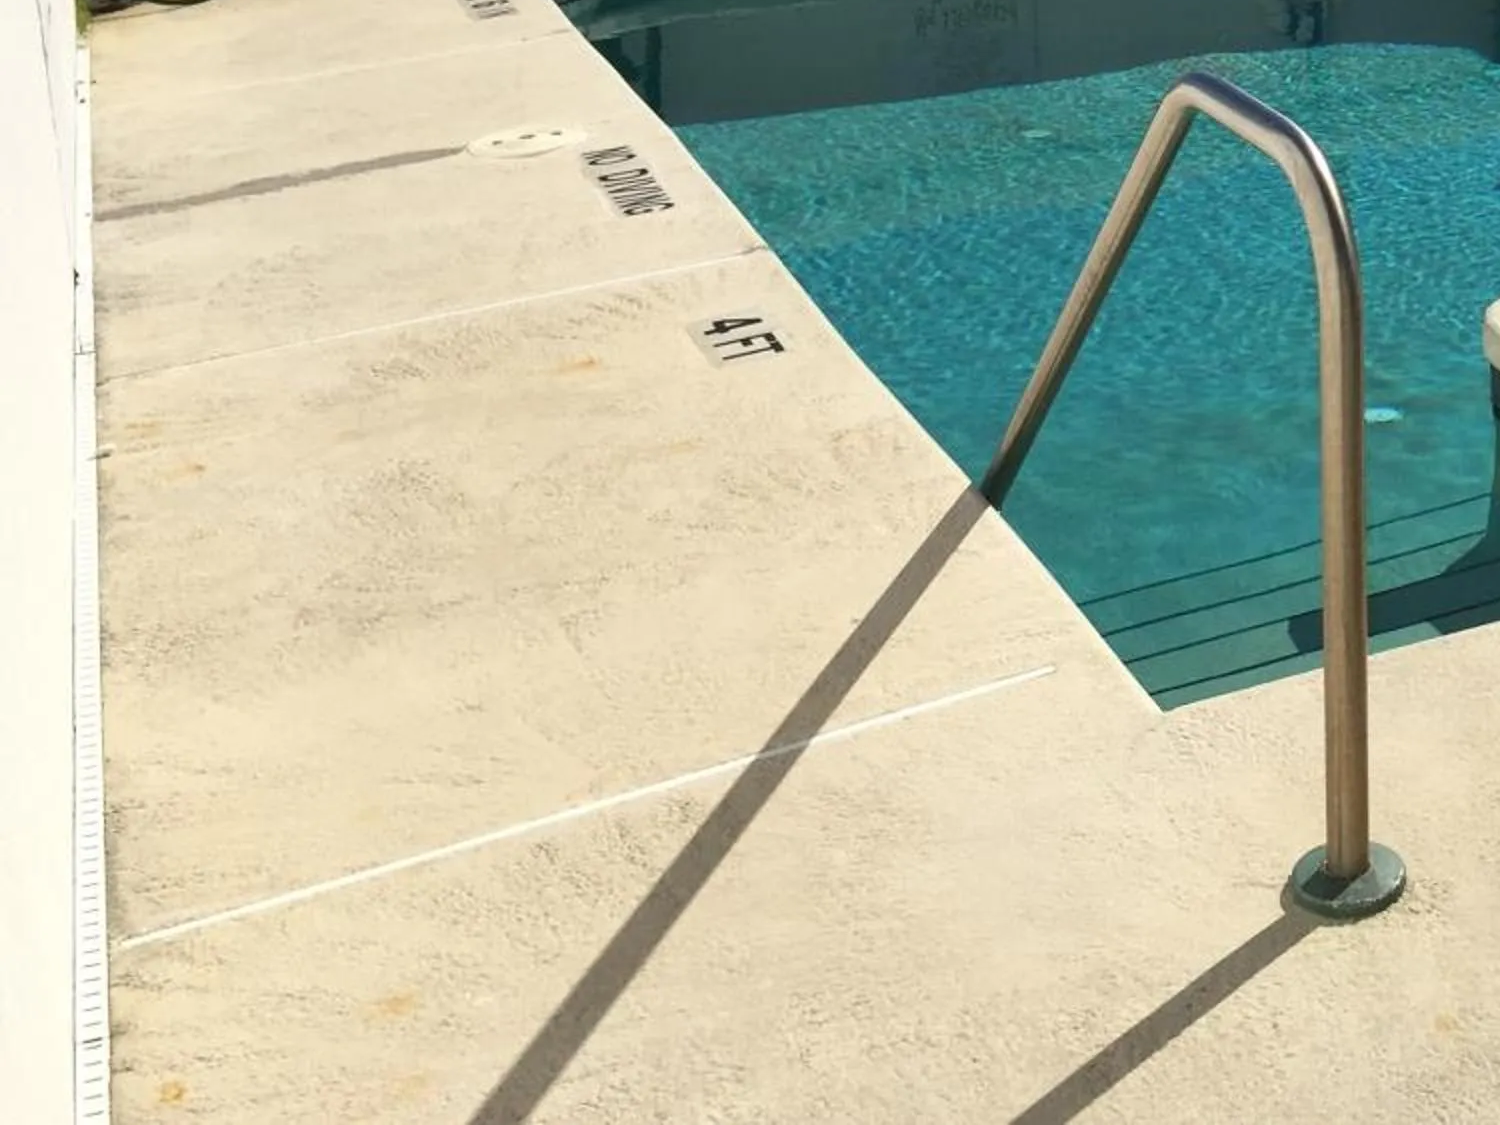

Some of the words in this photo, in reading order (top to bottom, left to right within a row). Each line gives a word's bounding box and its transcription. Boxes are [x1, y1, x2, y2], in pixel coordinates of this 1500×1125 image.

[582, 145, 637, 166] NO
[598, 168, 675, 216] DIVING
[703, 318, 763, 336] 4
[712, 332, 785, 362] FT
